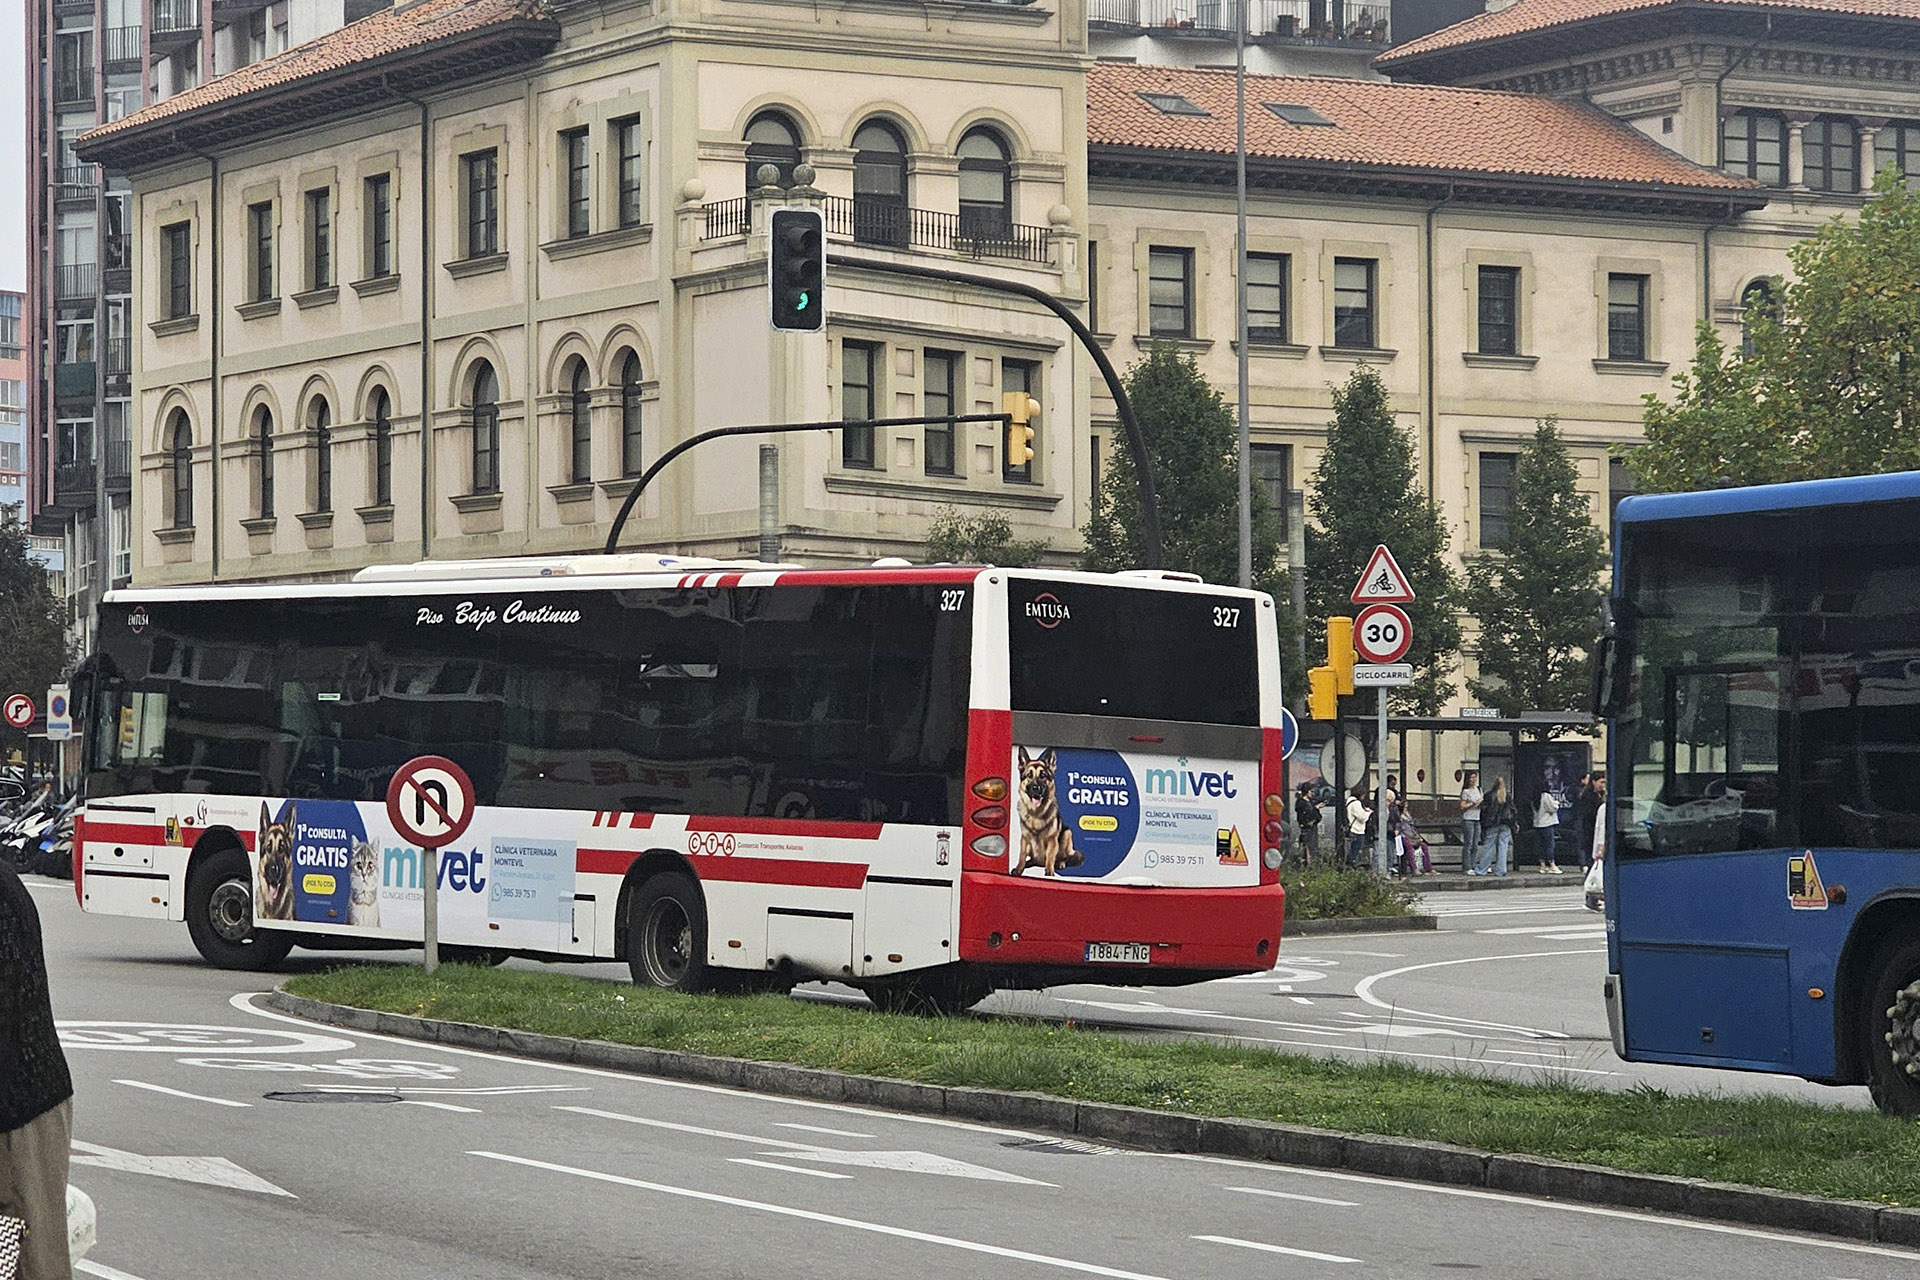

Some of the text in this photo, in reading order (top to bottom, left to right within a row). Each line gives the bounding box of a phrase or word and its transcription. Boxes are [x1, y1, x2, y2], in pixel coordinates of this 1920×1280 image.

[940, 589, 965, 611] 327
[415, 599, 582, 631] Piso Bajo Continuo
[1025, 602, 1071, 619] EMTUSA
[1213, 606, 1240, 628] 327
[127, 613, 149, 626] EMTUSA
[1367, 624, 1398, 643] 30
[1355, 671, 1410, 680] CICLOCARRIL
[1068, 771, 1127, 786] 1ª CONSULTA
[1146, 766, 1237, 799] mivet
[1068, 788, 1129, 806] GRATIS
[1145, 810, 1212, 821] CLÍNICA VETERINARIA
[297, 823, 348, 841] 1ª CONSULTA
[1145, 820, 1178, 828] MONTEVIL
[296, 845, 348, 868] GRATIS
[494, 844, 558, 857] CLÍNICA VETERINARIA
[494, 858, 524, 867] MONTEVIL
[1160, 855, 1204, 865] 985 39 75 11
[502, 888, 537, 899] 985 39 75 11
[1092, 945, 1148, 961] 1884 FNG
